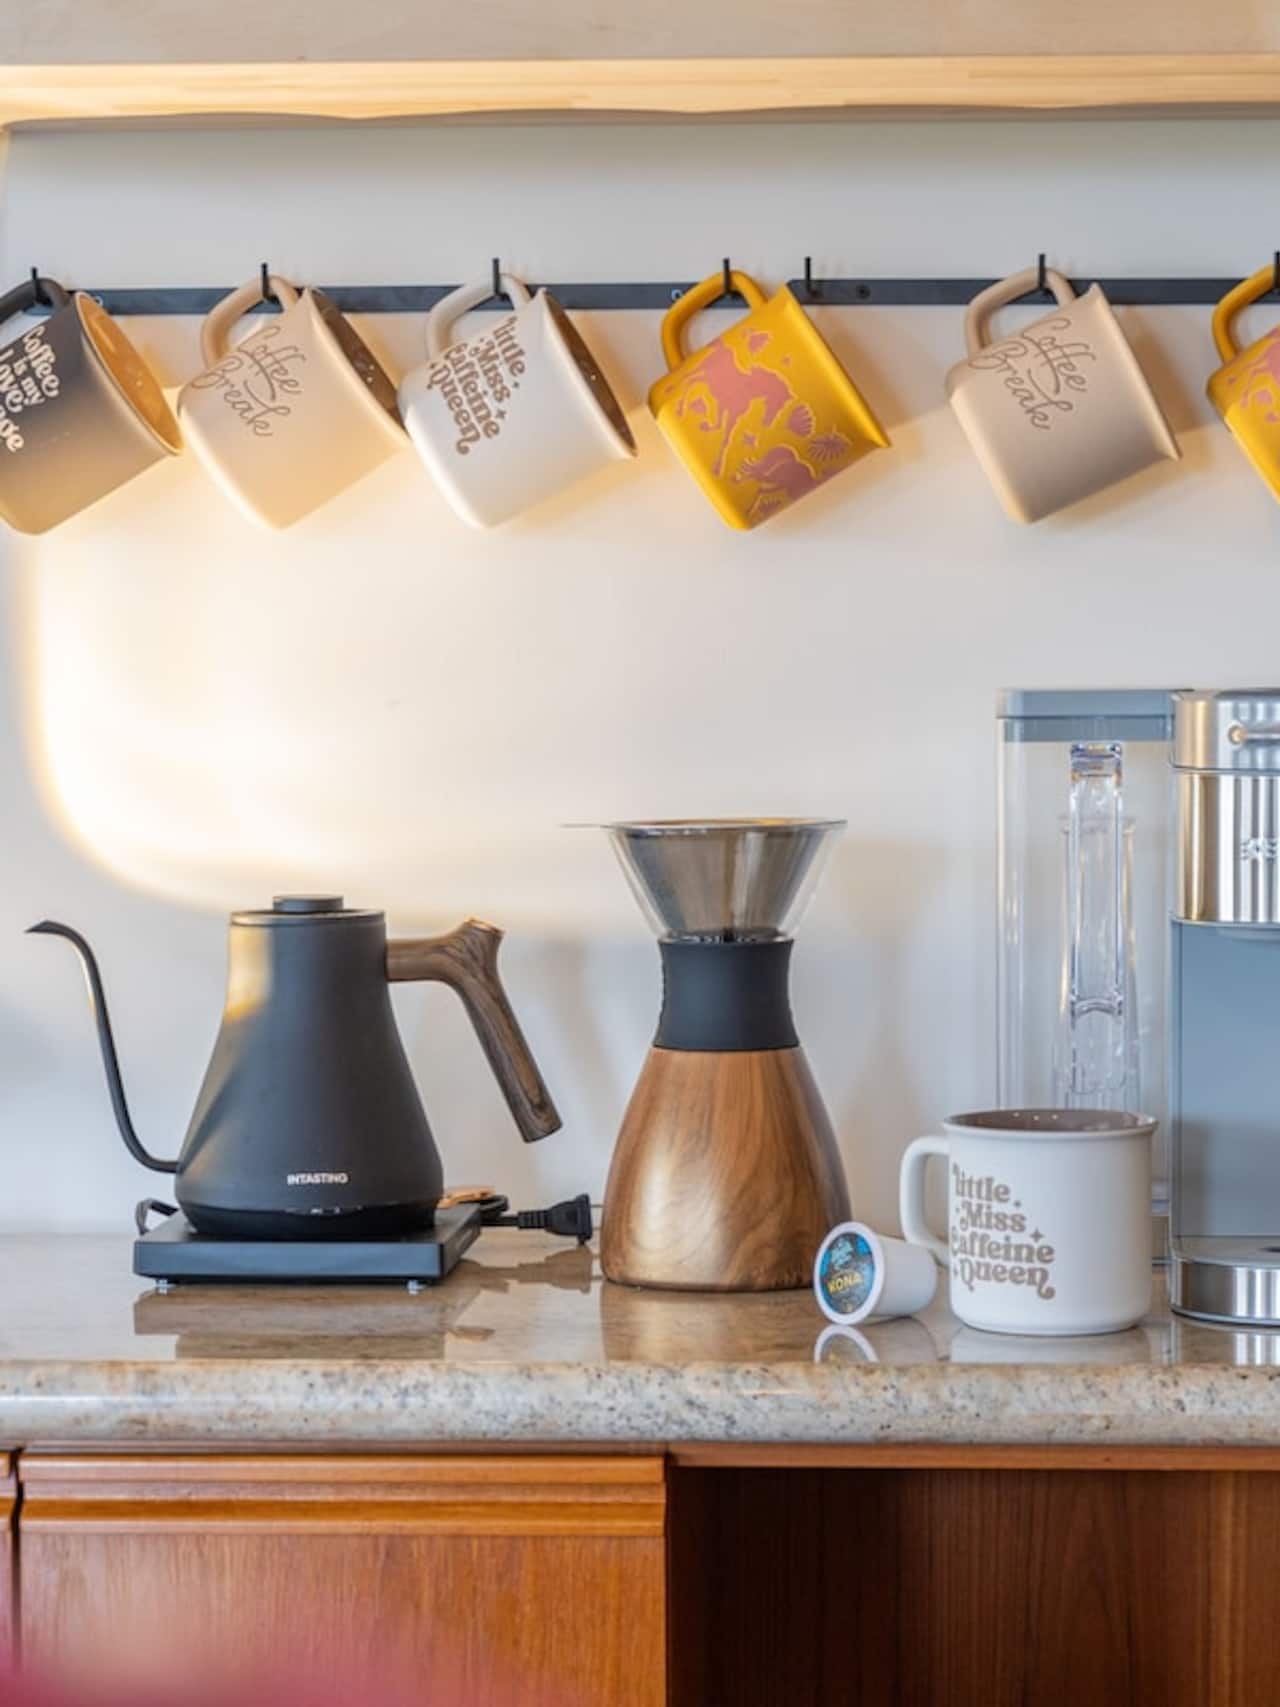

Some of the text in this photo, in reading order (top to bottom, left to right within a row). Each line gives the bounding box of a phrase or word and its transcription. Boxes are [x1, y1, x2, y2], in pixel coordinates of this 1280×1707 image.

[21, 376, 46, 406] my
[23, 325, 60, 397] Coffee
[237, 326, 306, 401] Coffee
[444, 343, 500, 439] Caffeine
[468, 339, 511, 403] Miss
[967, 340, 1074, 430] Break
[1021, 317, 1097, 395] Coffee
[191, 355, 291, 437] Break
[427, 365, 481, 455] Queen
[951, 1225, 1056, 1264] Caffeine
[959, 1200, 1028, 1233] Miss
[826, 1272, 863, 1296] KONA
[959, 1257, 1056, 1300] Queen
